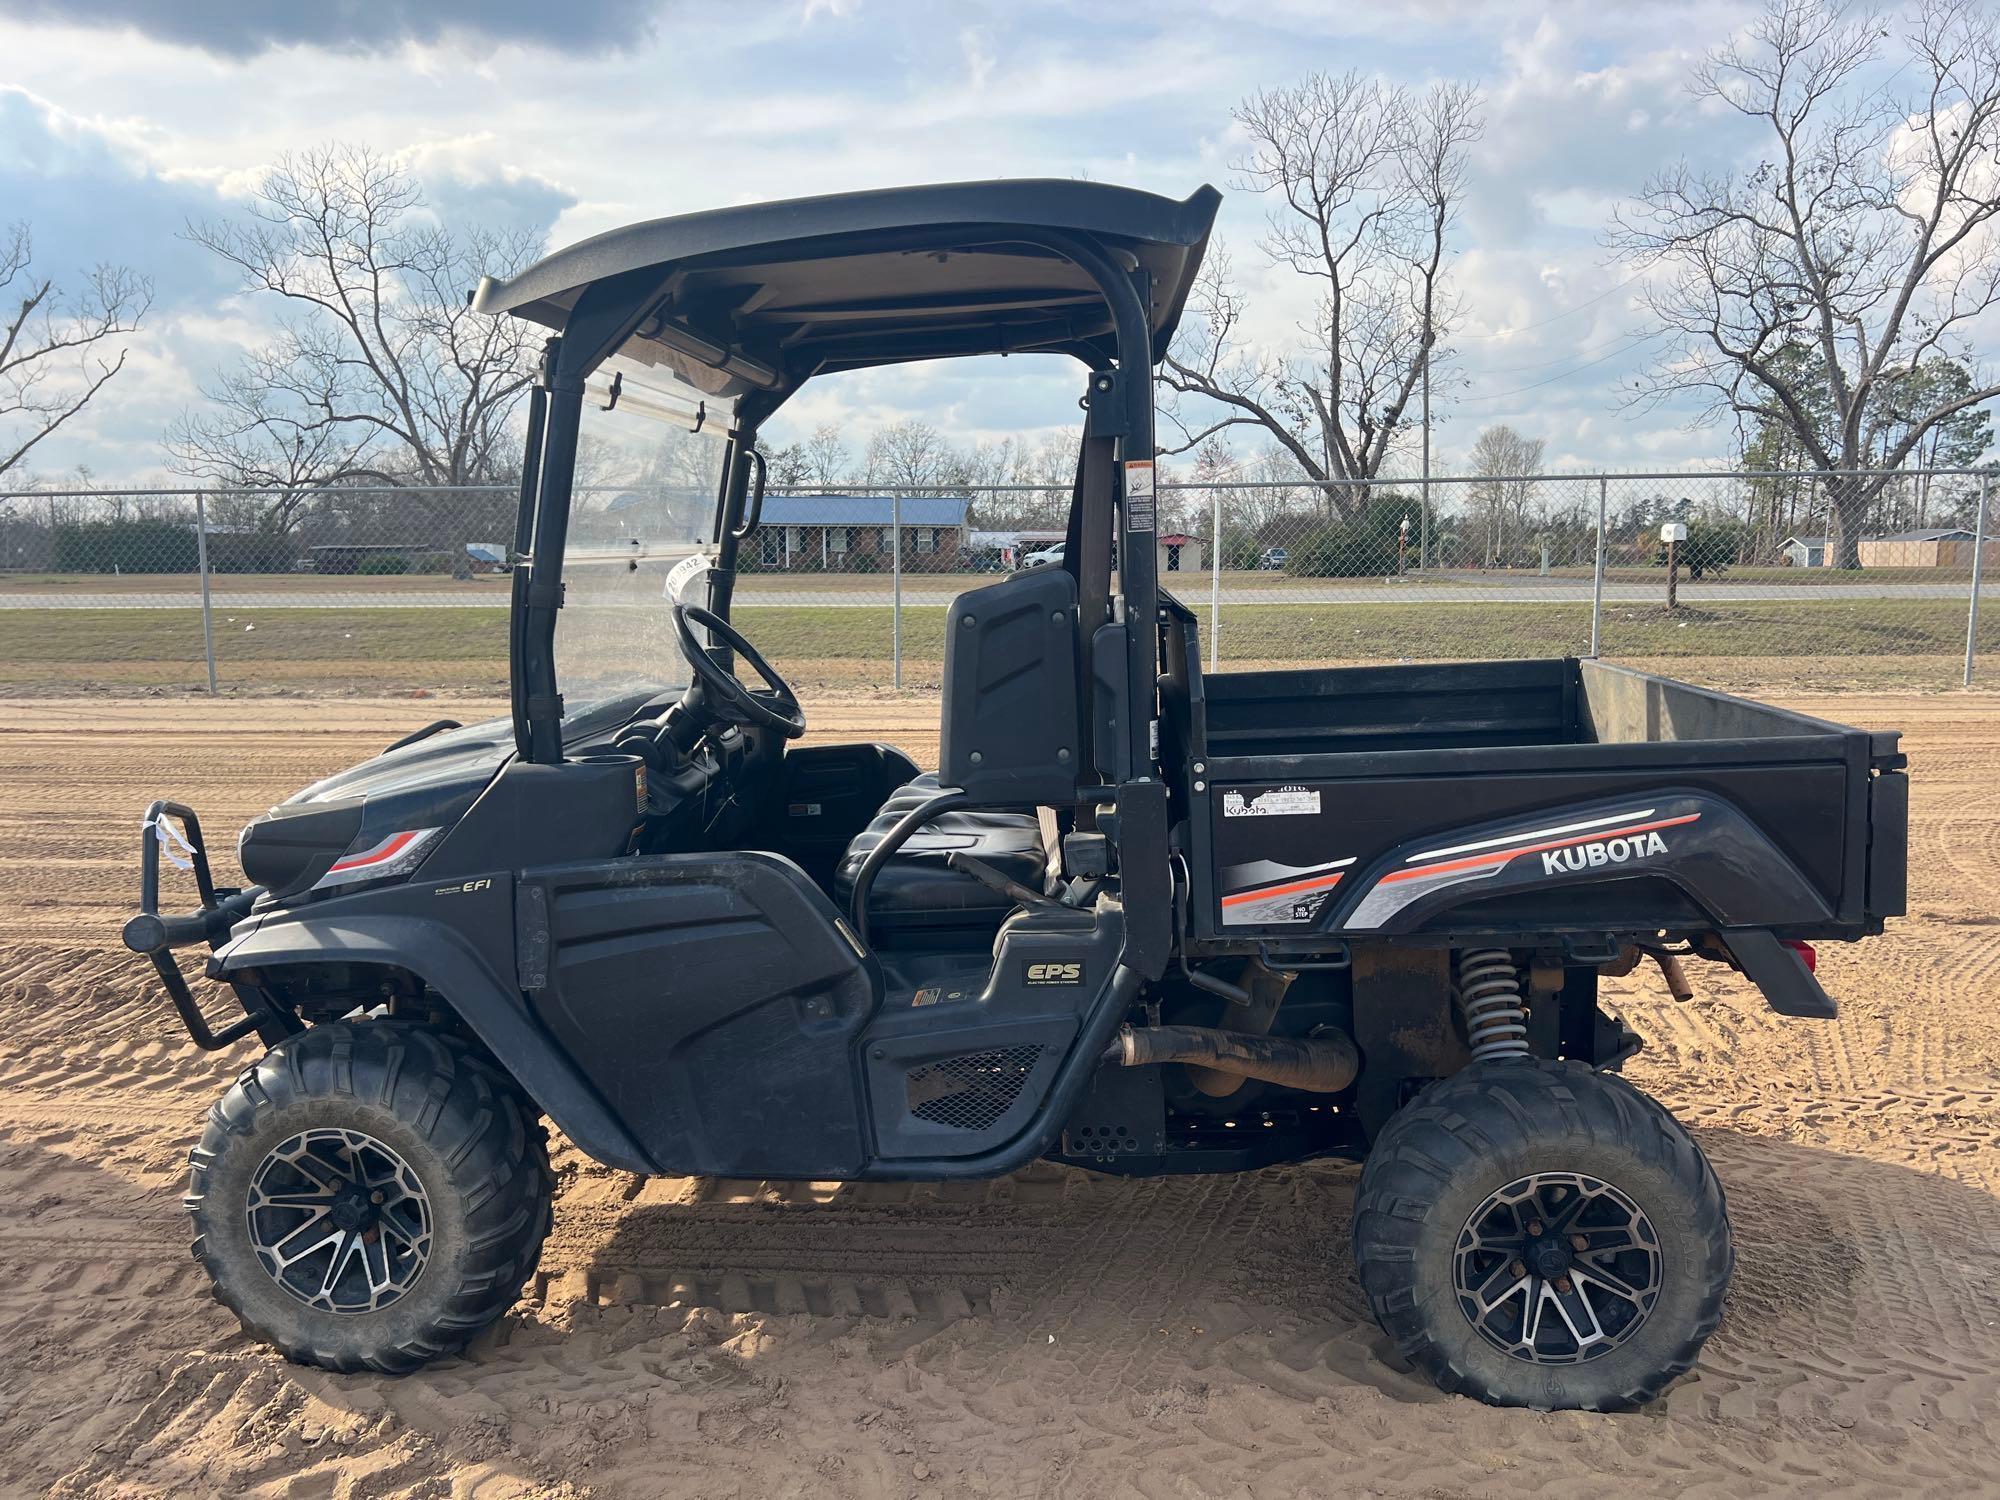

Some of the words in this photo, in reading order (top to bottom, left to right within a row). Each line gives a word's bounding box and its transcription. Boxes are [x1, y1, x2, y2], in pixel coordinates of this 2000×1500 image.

[1541, 831, 1669, 875] KUBOTA
[463, 879, 491, 892] EFI
[1028, 964, 1080, 979] EPS
